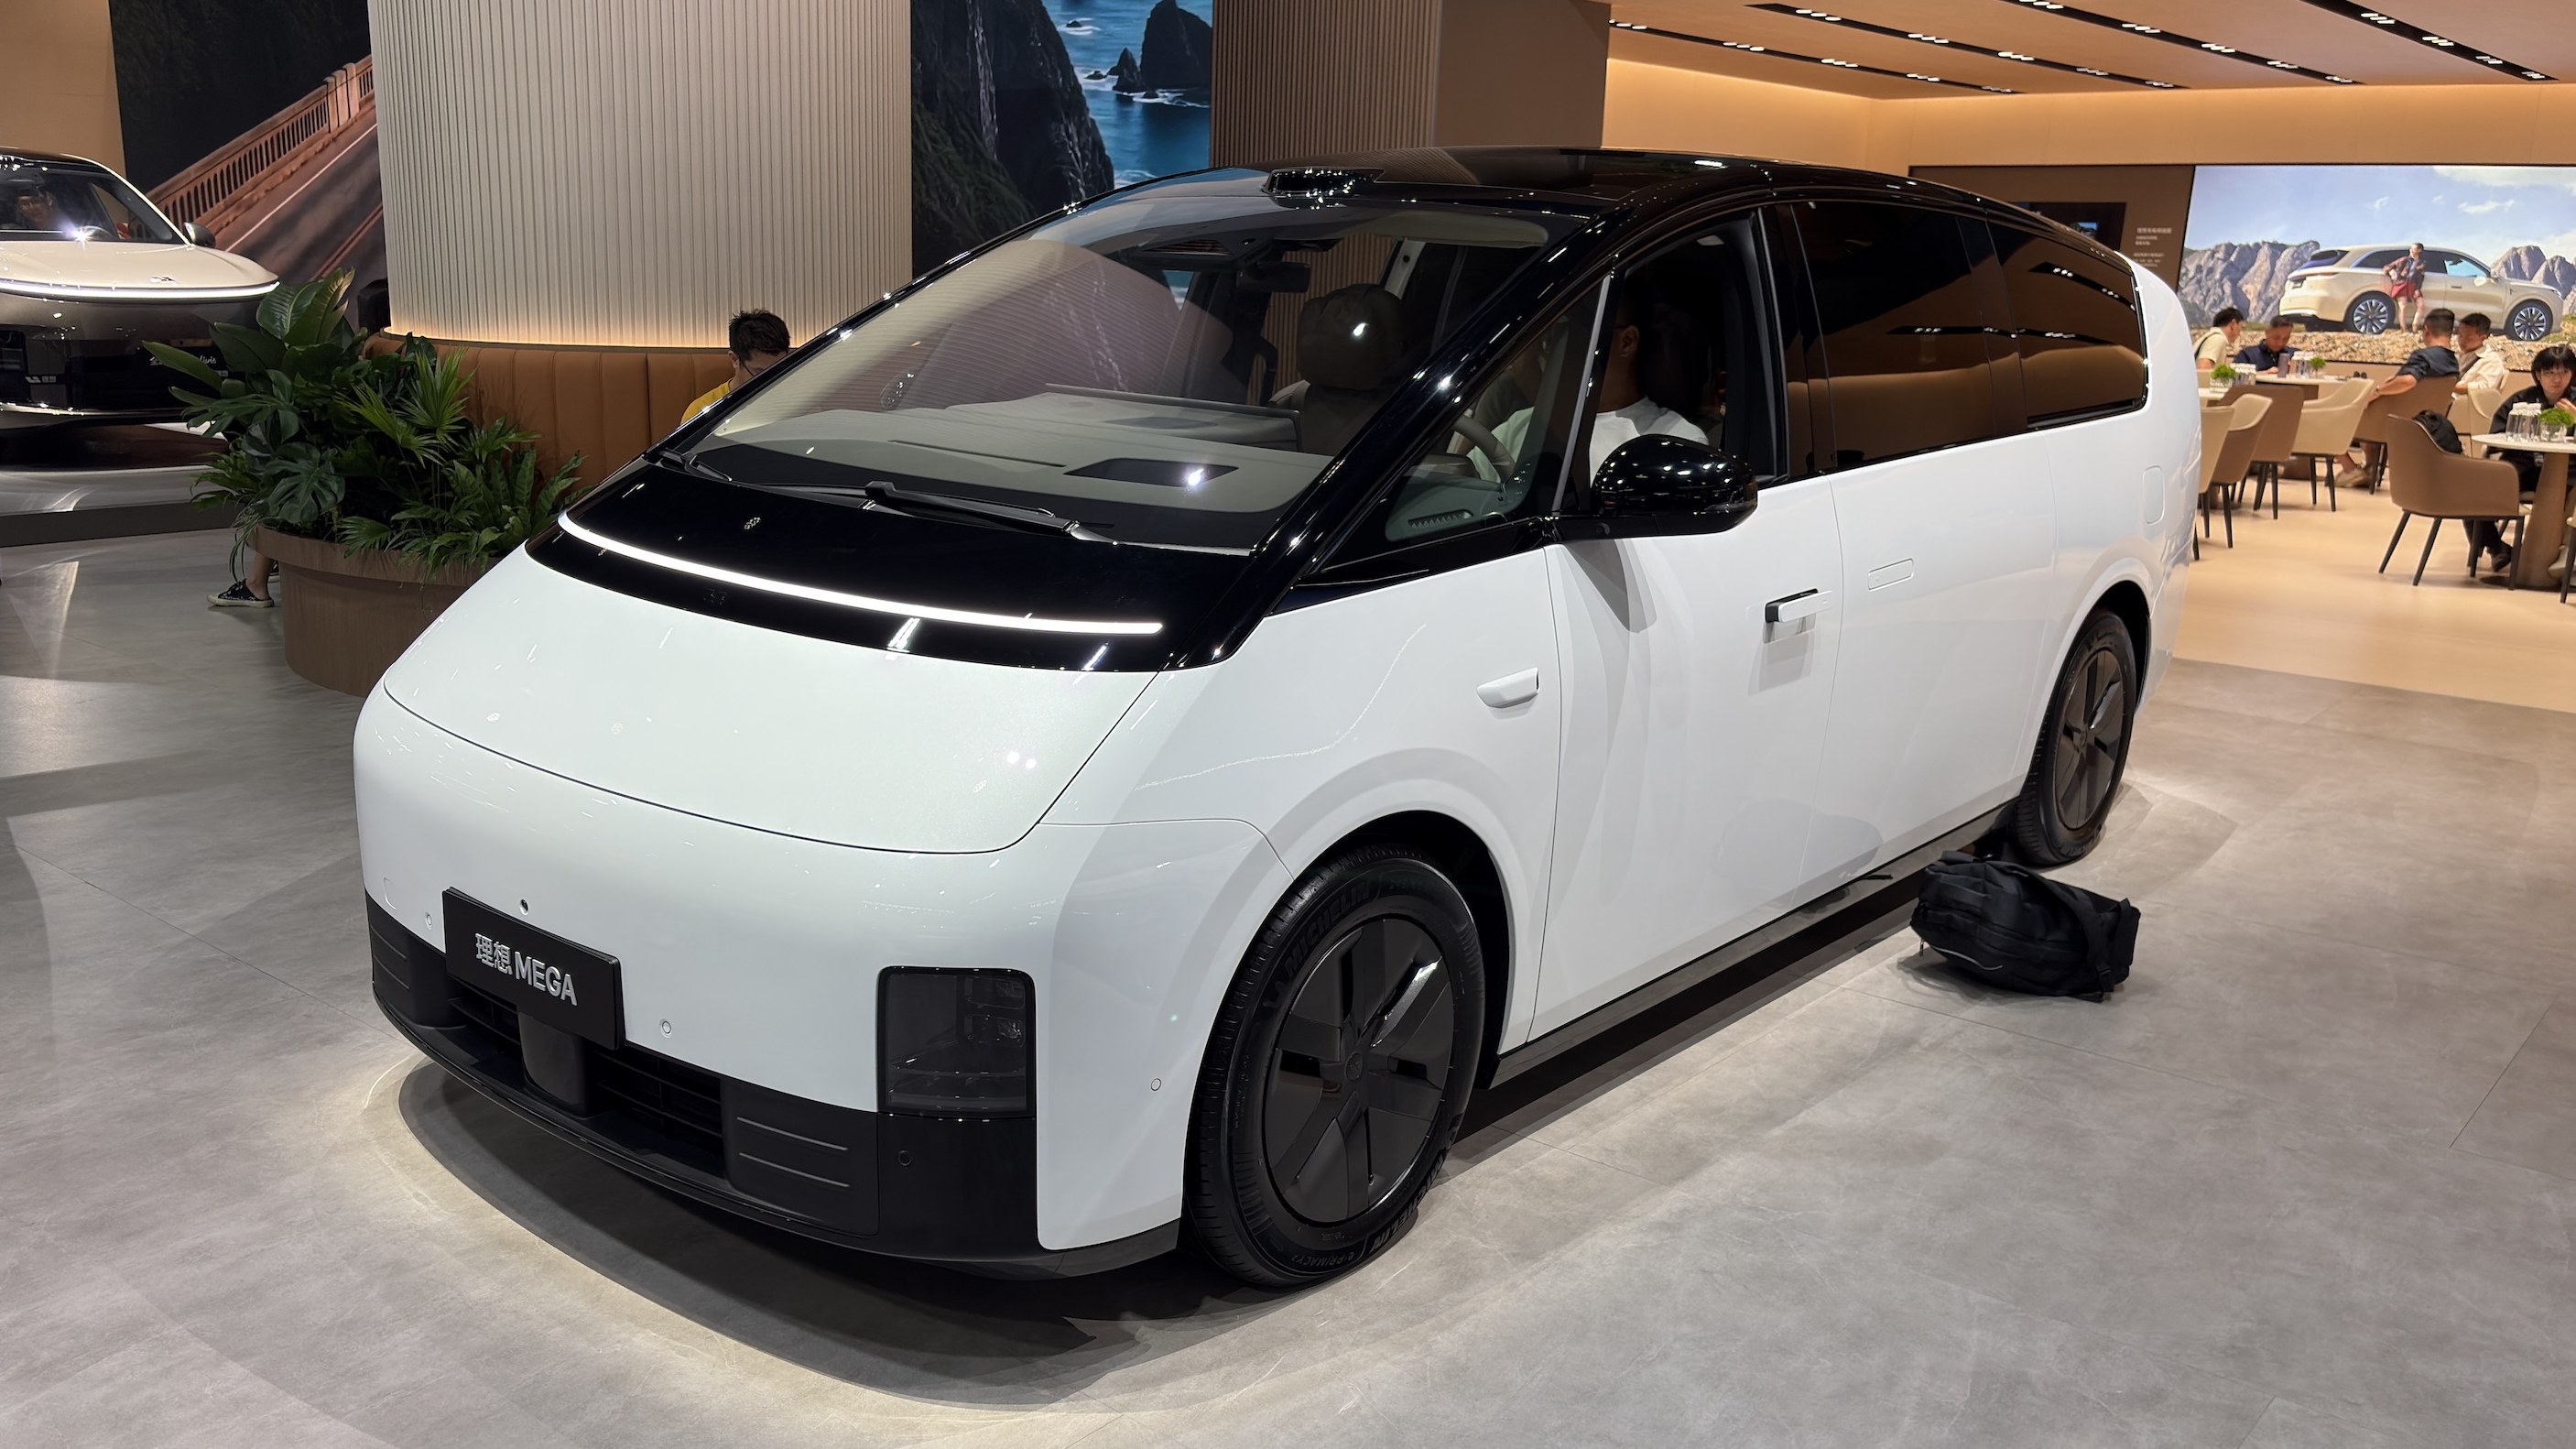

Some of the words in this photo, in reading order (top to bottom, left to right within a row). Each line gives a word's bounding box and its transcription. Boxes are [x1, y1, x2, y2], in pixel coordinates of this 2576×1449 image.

[474, 932, 513, 975] 理想
[514, 950, 578, 1007] MEGA
[1283, 879, 1373, 977] MICHELIN
